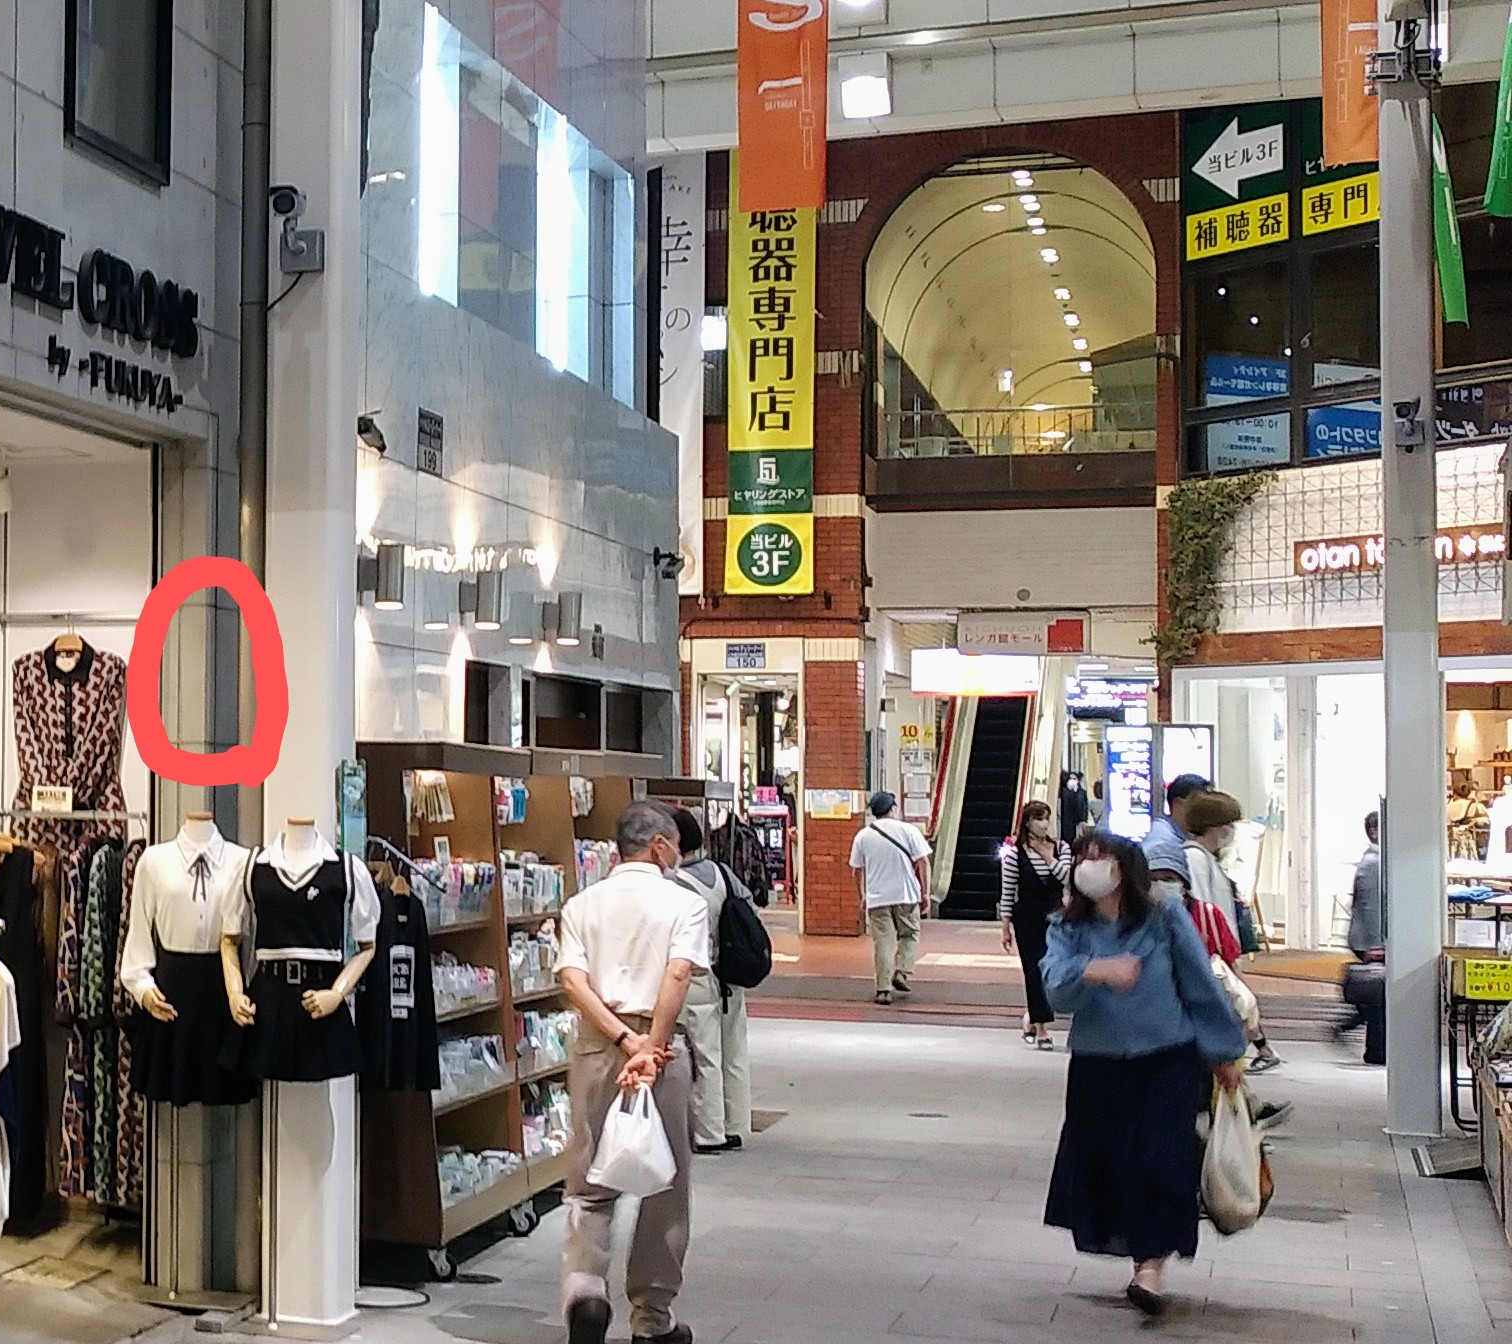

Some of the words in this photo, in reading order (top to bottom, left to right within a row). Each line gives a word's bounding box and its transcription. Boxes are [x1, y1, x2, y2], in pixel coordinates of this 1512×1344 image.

[1207, 139, 1280, 175] 当ビル3F
[1194, 201, 1284, 252] 補聴器
[1307, 182, 1380, 225] 専門
[734, 487, 806, 502] ヒヤリングストア
[750, 533, 794, 550] 当ビル
[750, 550, 791, 577] 3F
